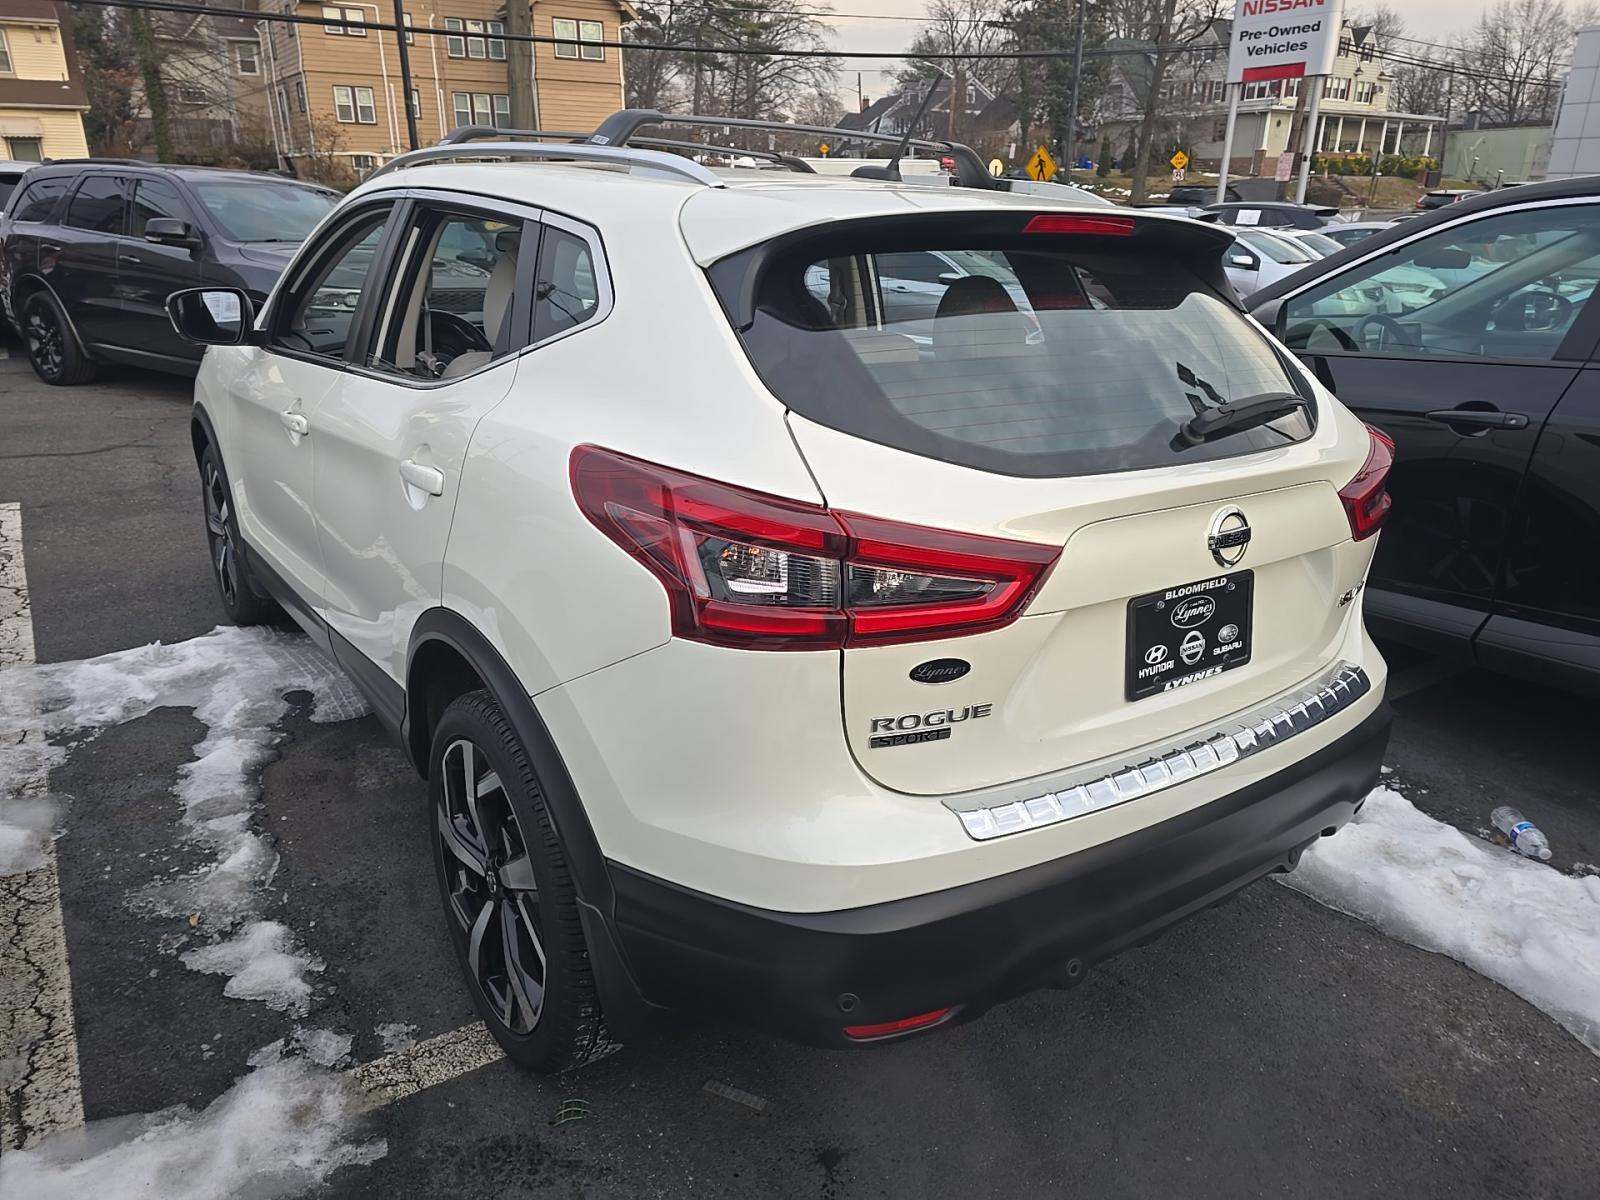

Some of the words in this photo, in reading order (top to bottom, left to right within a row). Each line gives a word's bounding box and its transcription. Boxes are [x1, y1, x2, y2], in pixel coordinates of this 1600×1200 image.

[1240, 21, 1321, 41] Pre-Owned
[1247, 41, 1308, 56] Vehicles
[1165, 578, 1228, 600] BLOOMFIELD
[1174, 603, 1213, 622] Lynnes
[1213, 641, 1242, 655] SUBARU
[1138, 660, 1175, 678] HYUNDAI
[1164, 665, 1223, 692] LYNNES
[871, 703, 992, 733] ROGUE
[877, 729, 942, 747] SPORT
